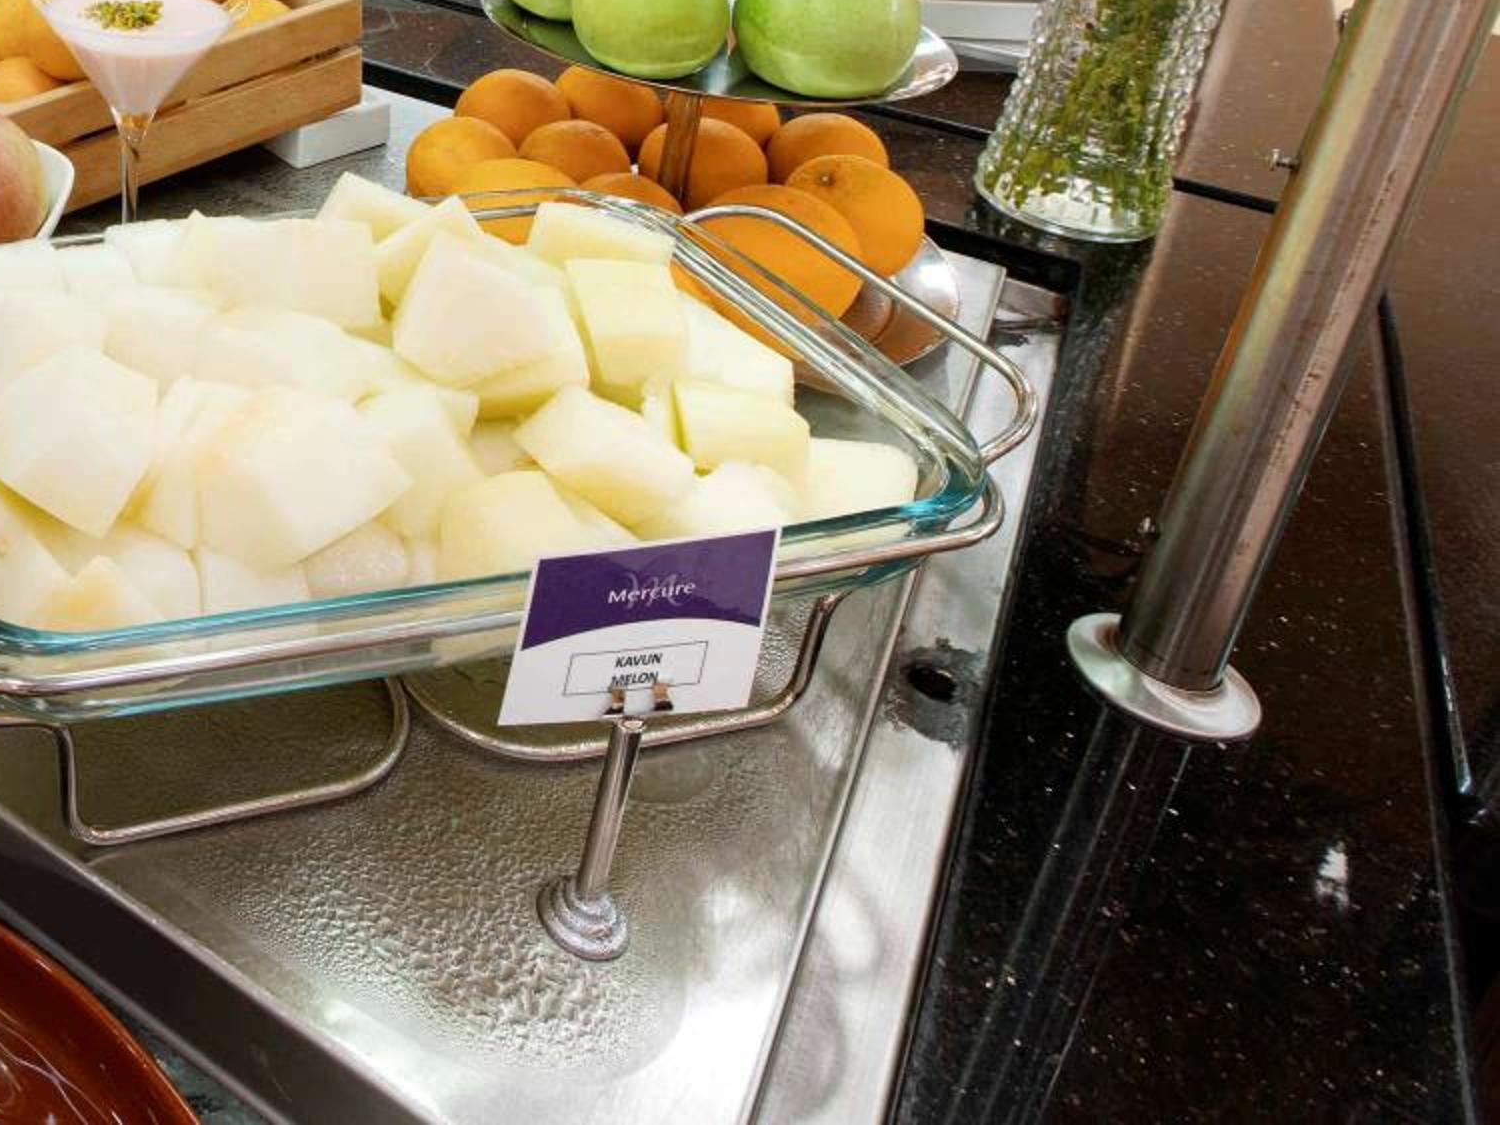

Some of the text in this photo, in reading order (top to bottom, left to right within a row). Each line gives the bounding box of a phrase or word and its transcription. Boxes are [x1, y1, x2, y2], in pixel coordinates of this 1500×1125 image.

[607, 578, 696, 605] Mercure
[614, 653, 662, 669] KAVUN
[610, 671, 659, 687] MELON
